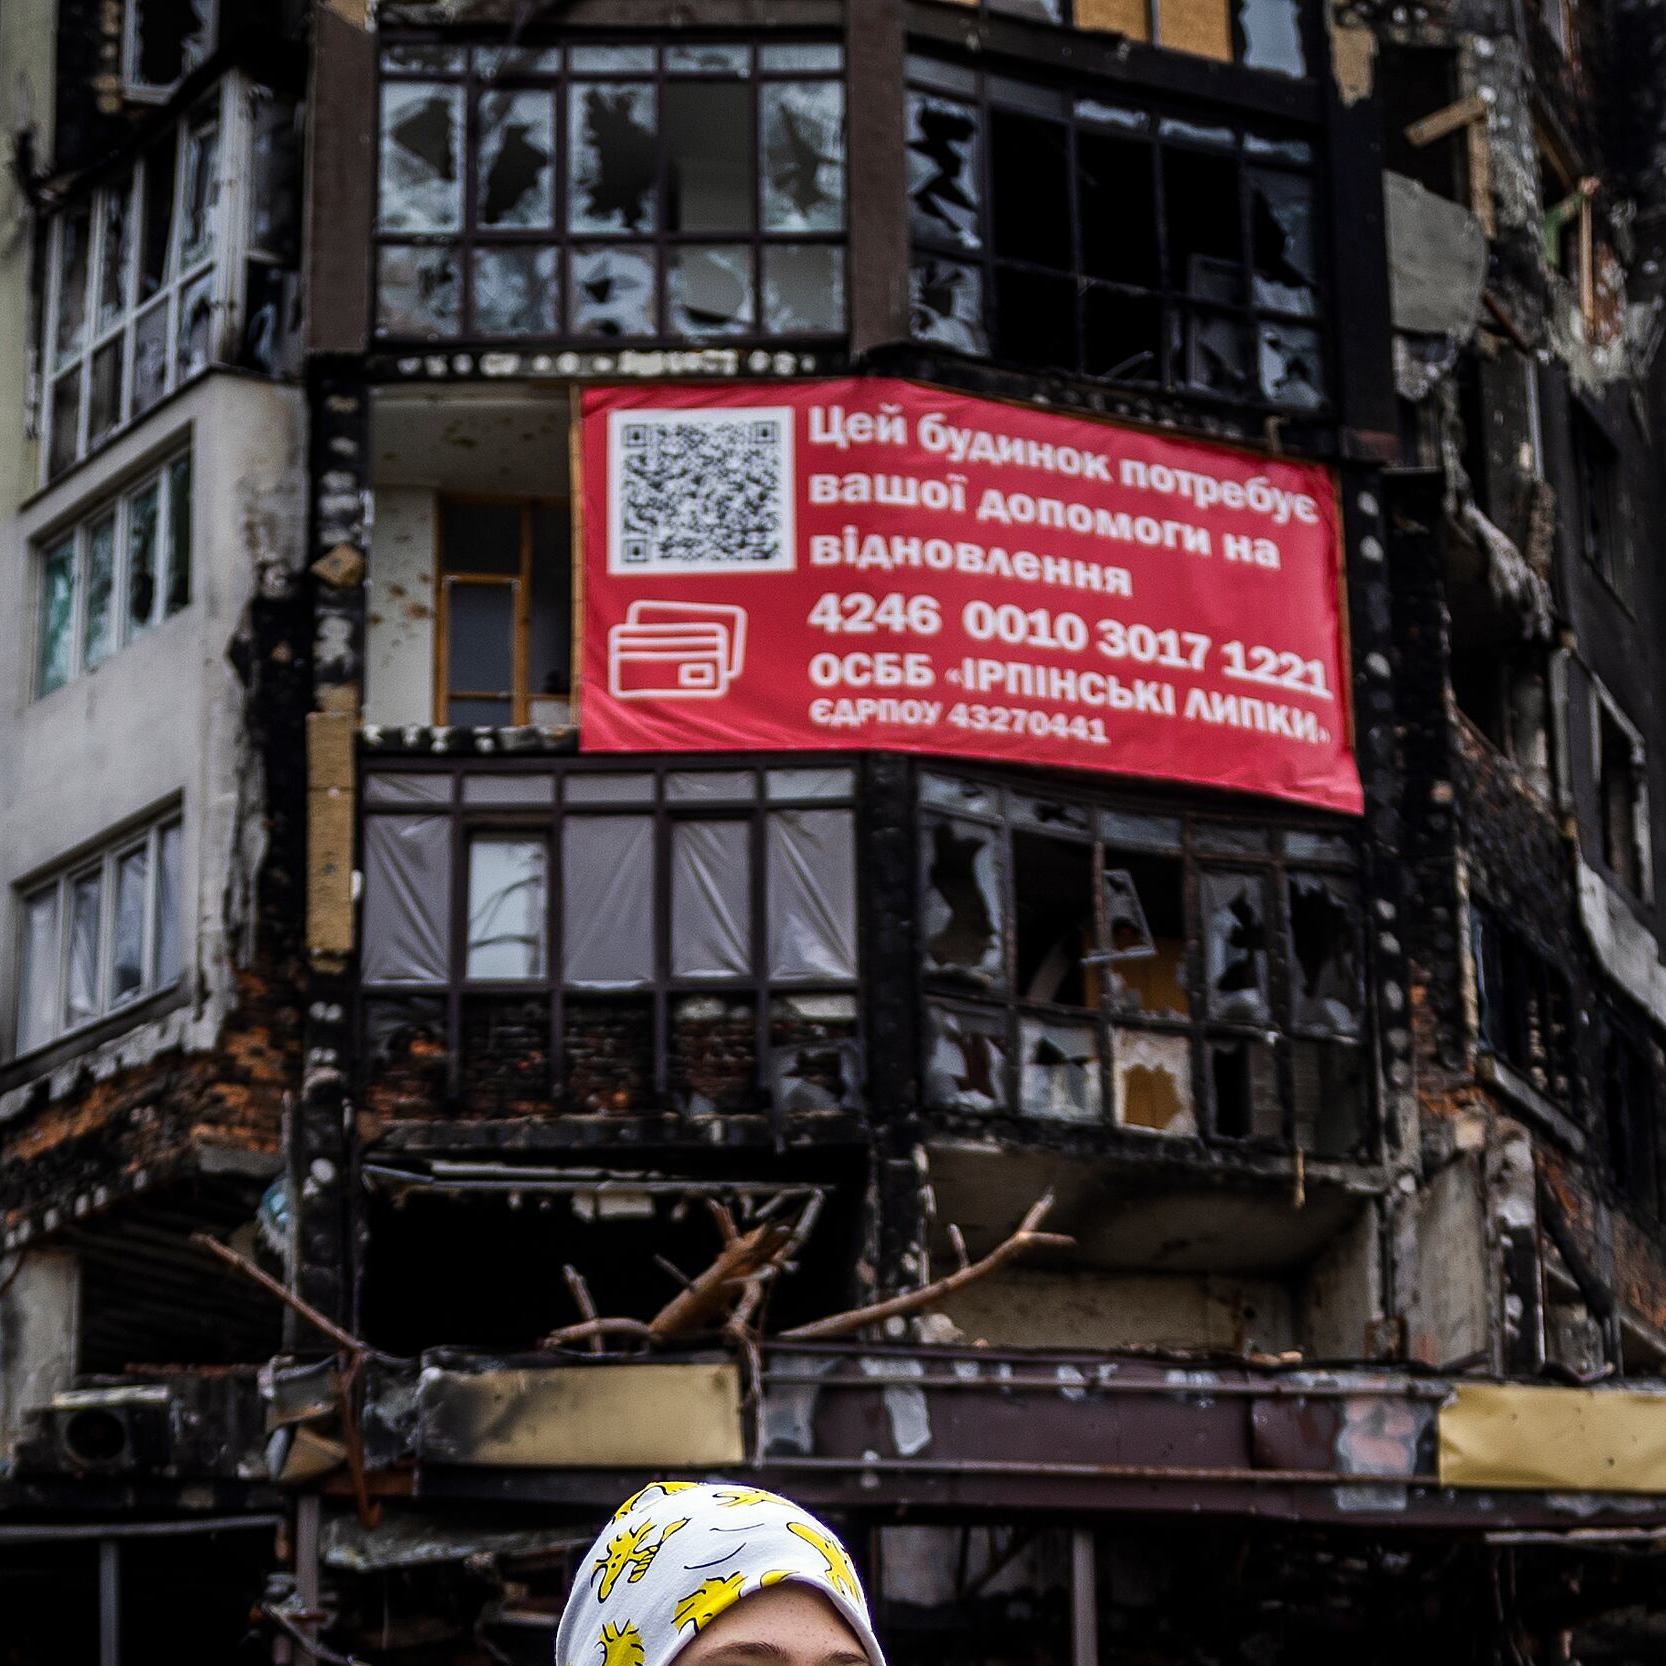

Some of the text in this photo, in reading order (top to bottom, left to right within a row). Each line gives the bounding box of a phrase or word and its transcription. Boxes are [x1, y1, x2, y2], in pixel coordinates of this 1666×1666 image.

[808, 402, 1319, 524] Цей будинок потребує
[808, 473, 1281, 570] вашої допомоги на
[809, 524, 1132, 597] відновлення
[806, 592, 1333, 700] 4246 0010 3017 1221
[808, 651, 1332, 744] ОСББ «ІРПІНСЬКІ ЛИПКИ»
[808, 697, 1111, 744] ЄДРПОУ 43270441
